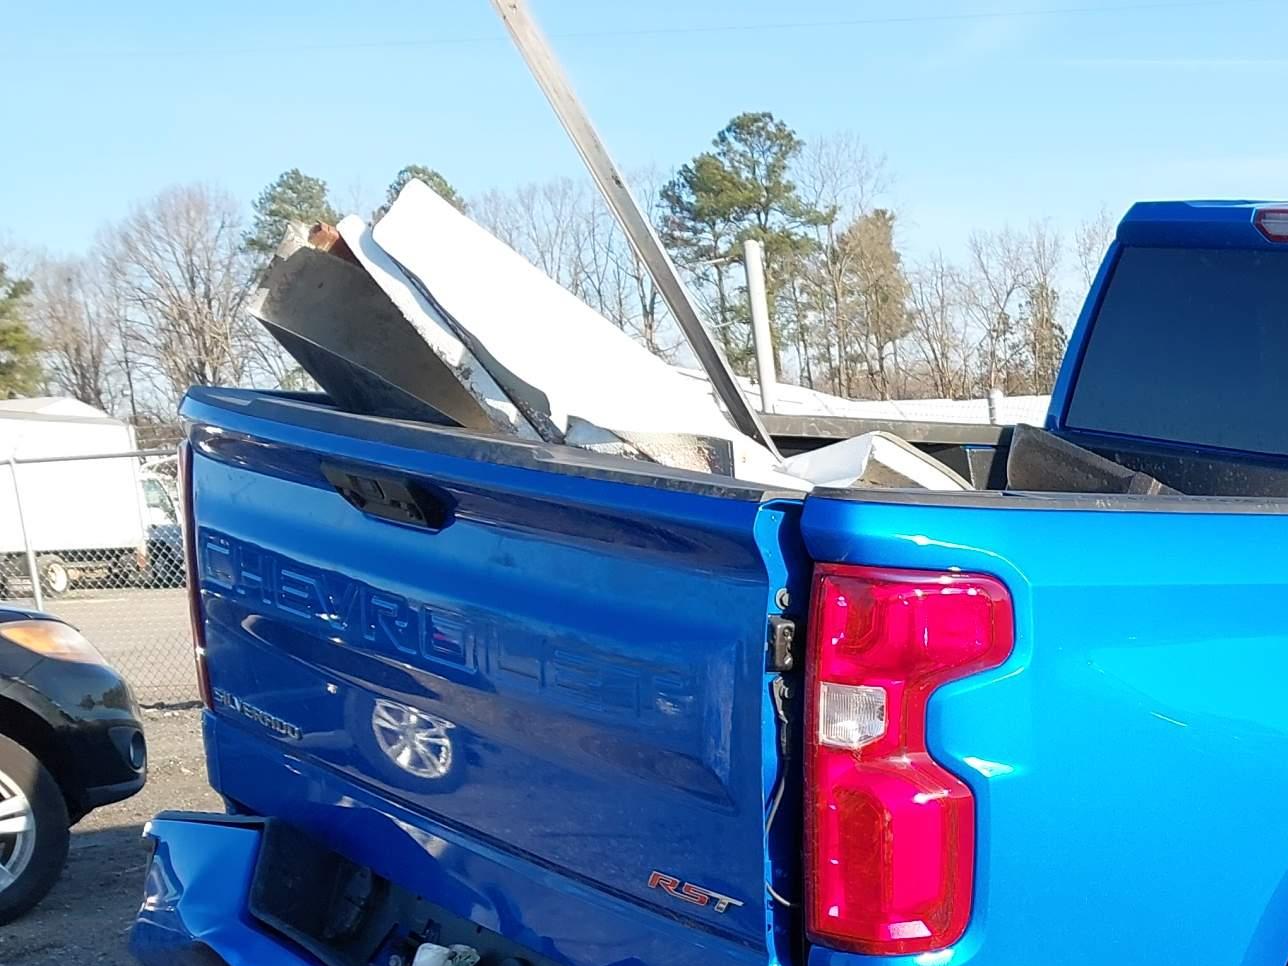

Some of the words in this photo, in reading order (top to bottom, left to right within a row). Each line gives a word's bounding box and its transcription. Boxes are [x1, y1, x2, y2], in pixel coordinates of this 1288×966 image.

[197, 533, 692, 718] CHEVROLET
[212, 687, 303, 740] SILVERADO
[647, 870, 744, 913] RST
